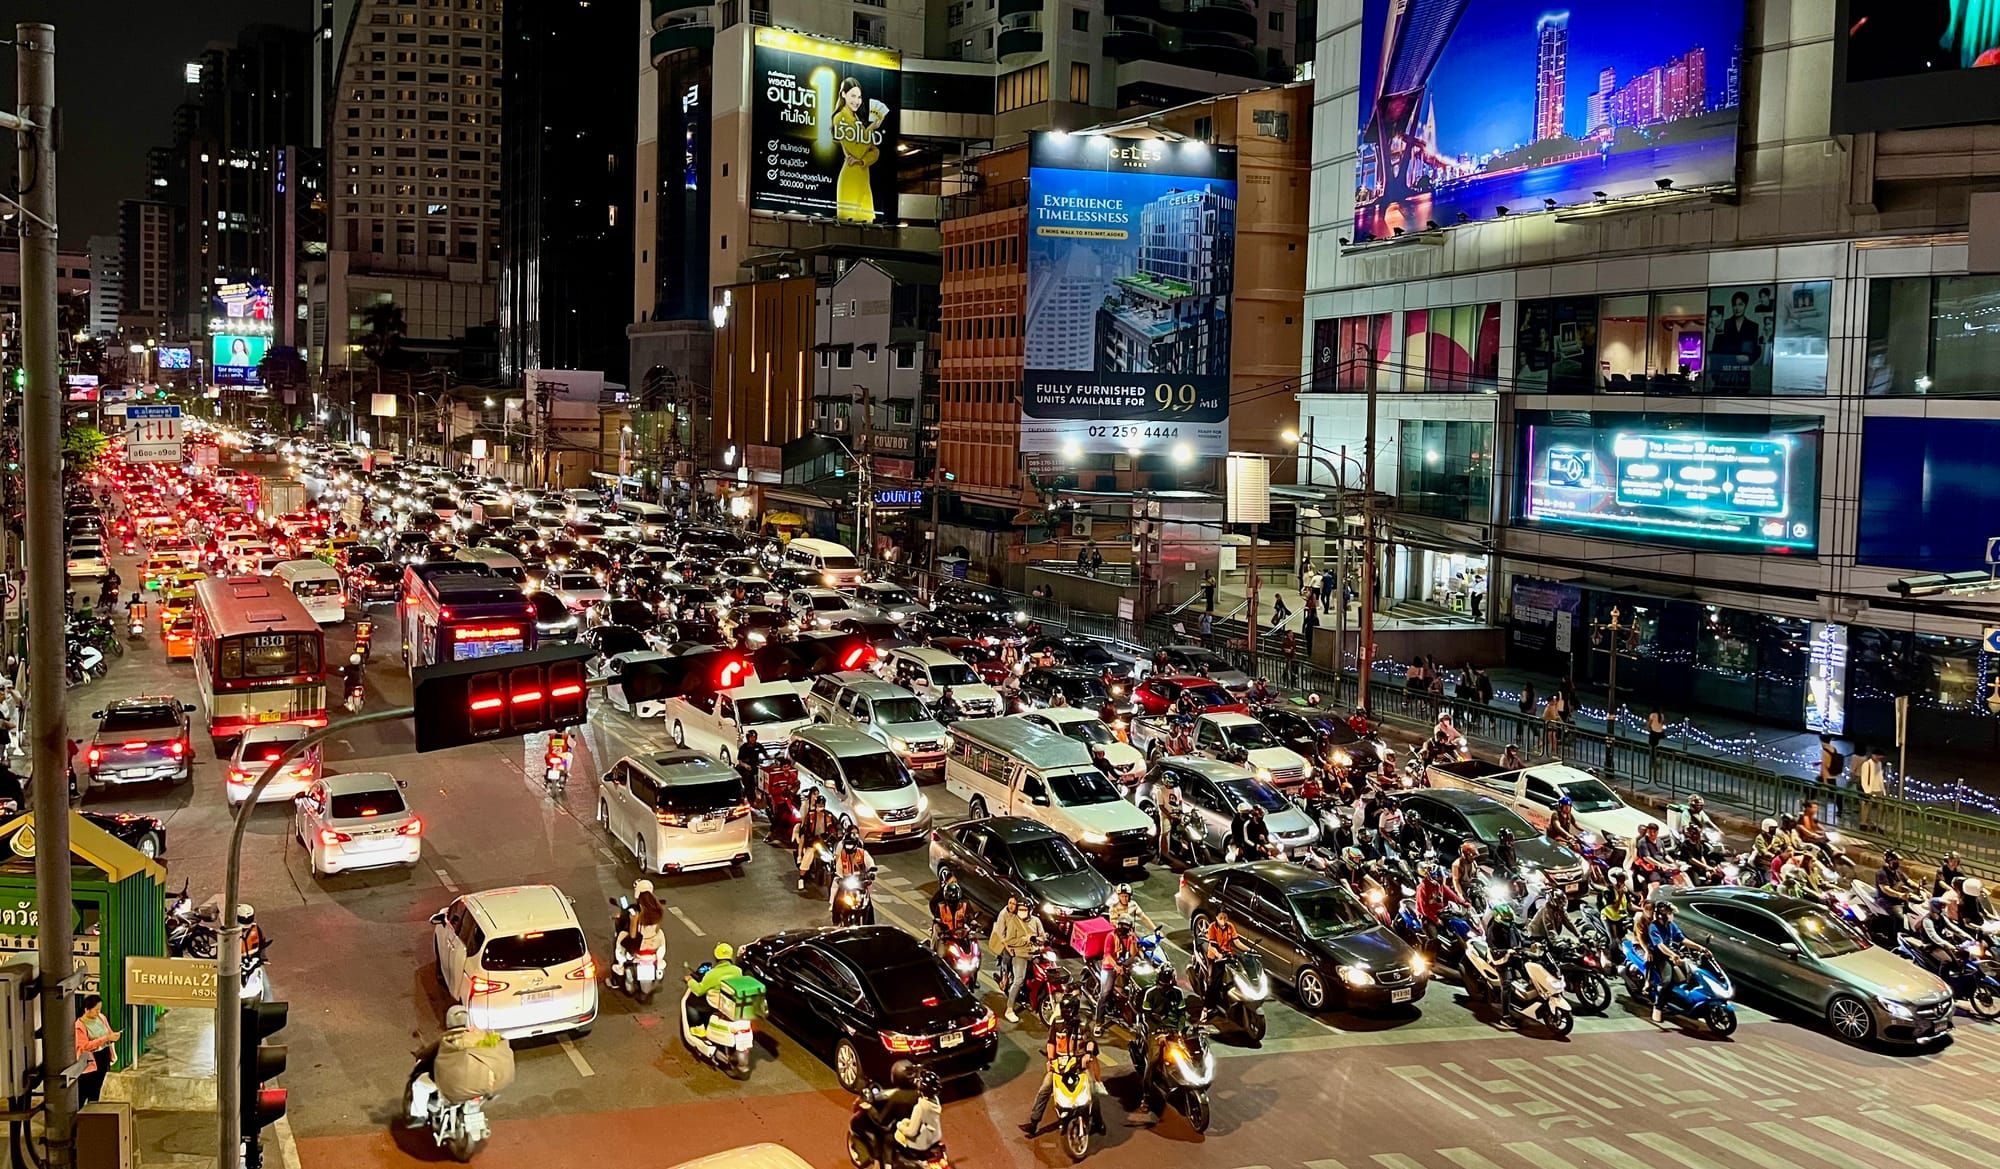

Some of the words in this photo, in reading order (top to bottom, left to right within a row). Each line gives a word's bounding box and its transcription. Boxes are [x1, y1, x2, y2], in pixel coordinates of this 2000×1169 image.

[767, 87, 817, 109] อนุมัติ
[810, 67, 835, 150] 1
[1109, 147, 1162, 161] CELES
[1169, 193, 1200, 206] CELES
[1036, 384, 1073, 394] FULLY
[1077, 385, 1146, 396] FURNISHED
[1036, 395, 1066, 405] UNITS
[1069, 396, 1122, 406] AVAILABLE
[1125, 397, 1145, 406] FOR
[1088, 426, 1106, 437] 02
[1112, 426, 1138, 438] 259
[1144, 427, 1178, 439] 4444
[874, 435, 909, 449] COWBOY
